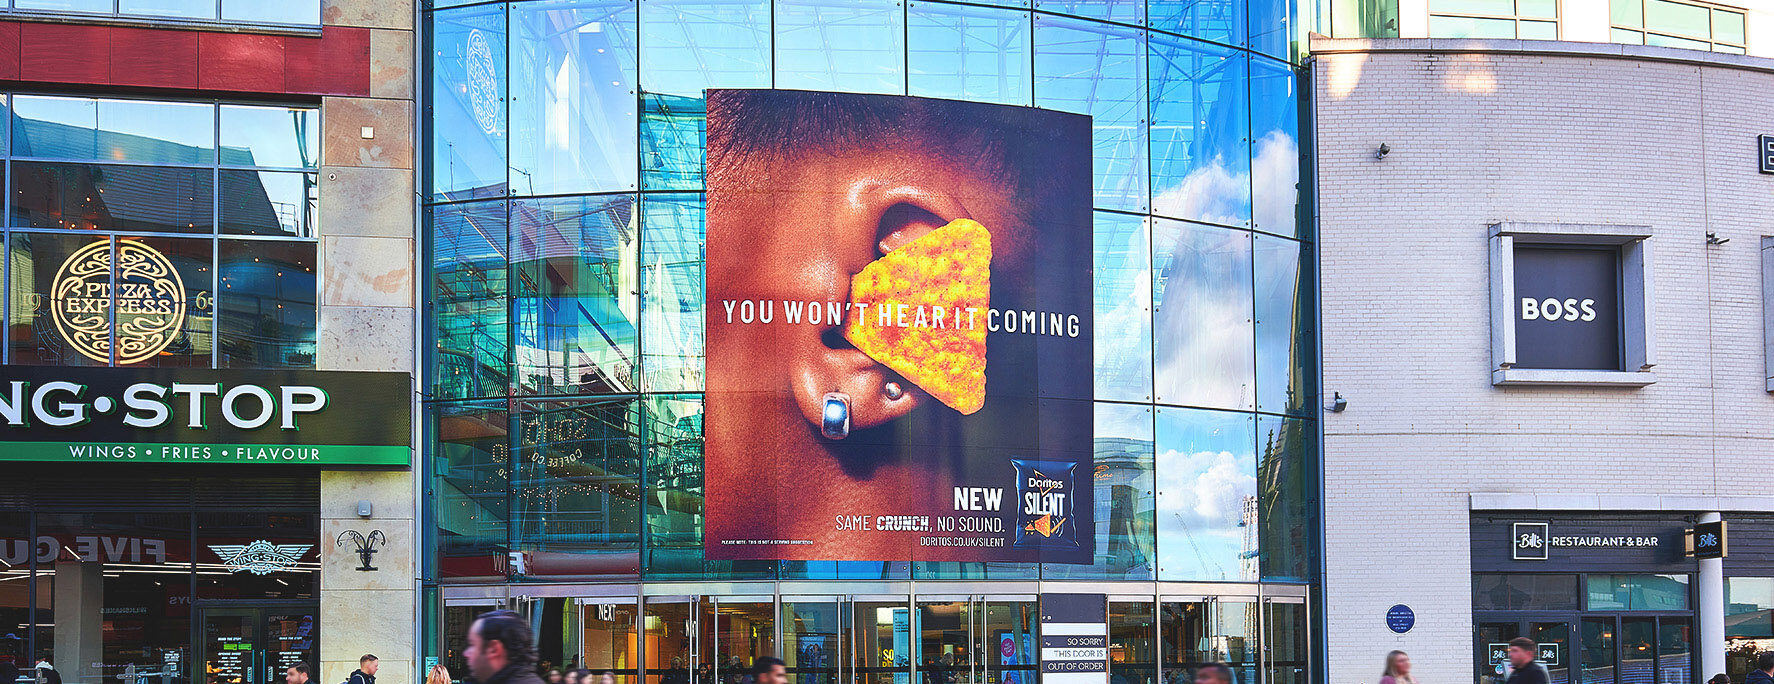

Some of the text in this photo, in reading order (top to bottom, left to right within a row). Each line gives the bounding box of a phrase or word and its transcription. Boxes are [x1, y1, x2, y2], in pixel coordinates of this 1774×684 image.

[1521, 297, 1597, 322] BOSS
[722, 300, 1081, 338] YOU WON'T HEAR IT COMING
[69, 445, 320, 461] WINGS FRIES FLAVOUR
[1028, 477, 1064, 489] Doritos
[954, 486, 1003, 511] NEW
[1024, 491, 1066, 516] SILENT
[835, 514, 1006, 533] SAME CRUNCH, NO SOUND.
[920, 536, 1005, 547] DORITOS.CO.UK/SILENT
[1518, 532, 1659, 548] Bill's RESTAURANT & BAR
[598, 603, 617, 621] NEXT
[1067, 637, 1104, 646] SO SORRY
[1054, 649, 1104, 658] THIS DOOR IS
[1047, 662, 1104, 671] OUT OF ORDER
